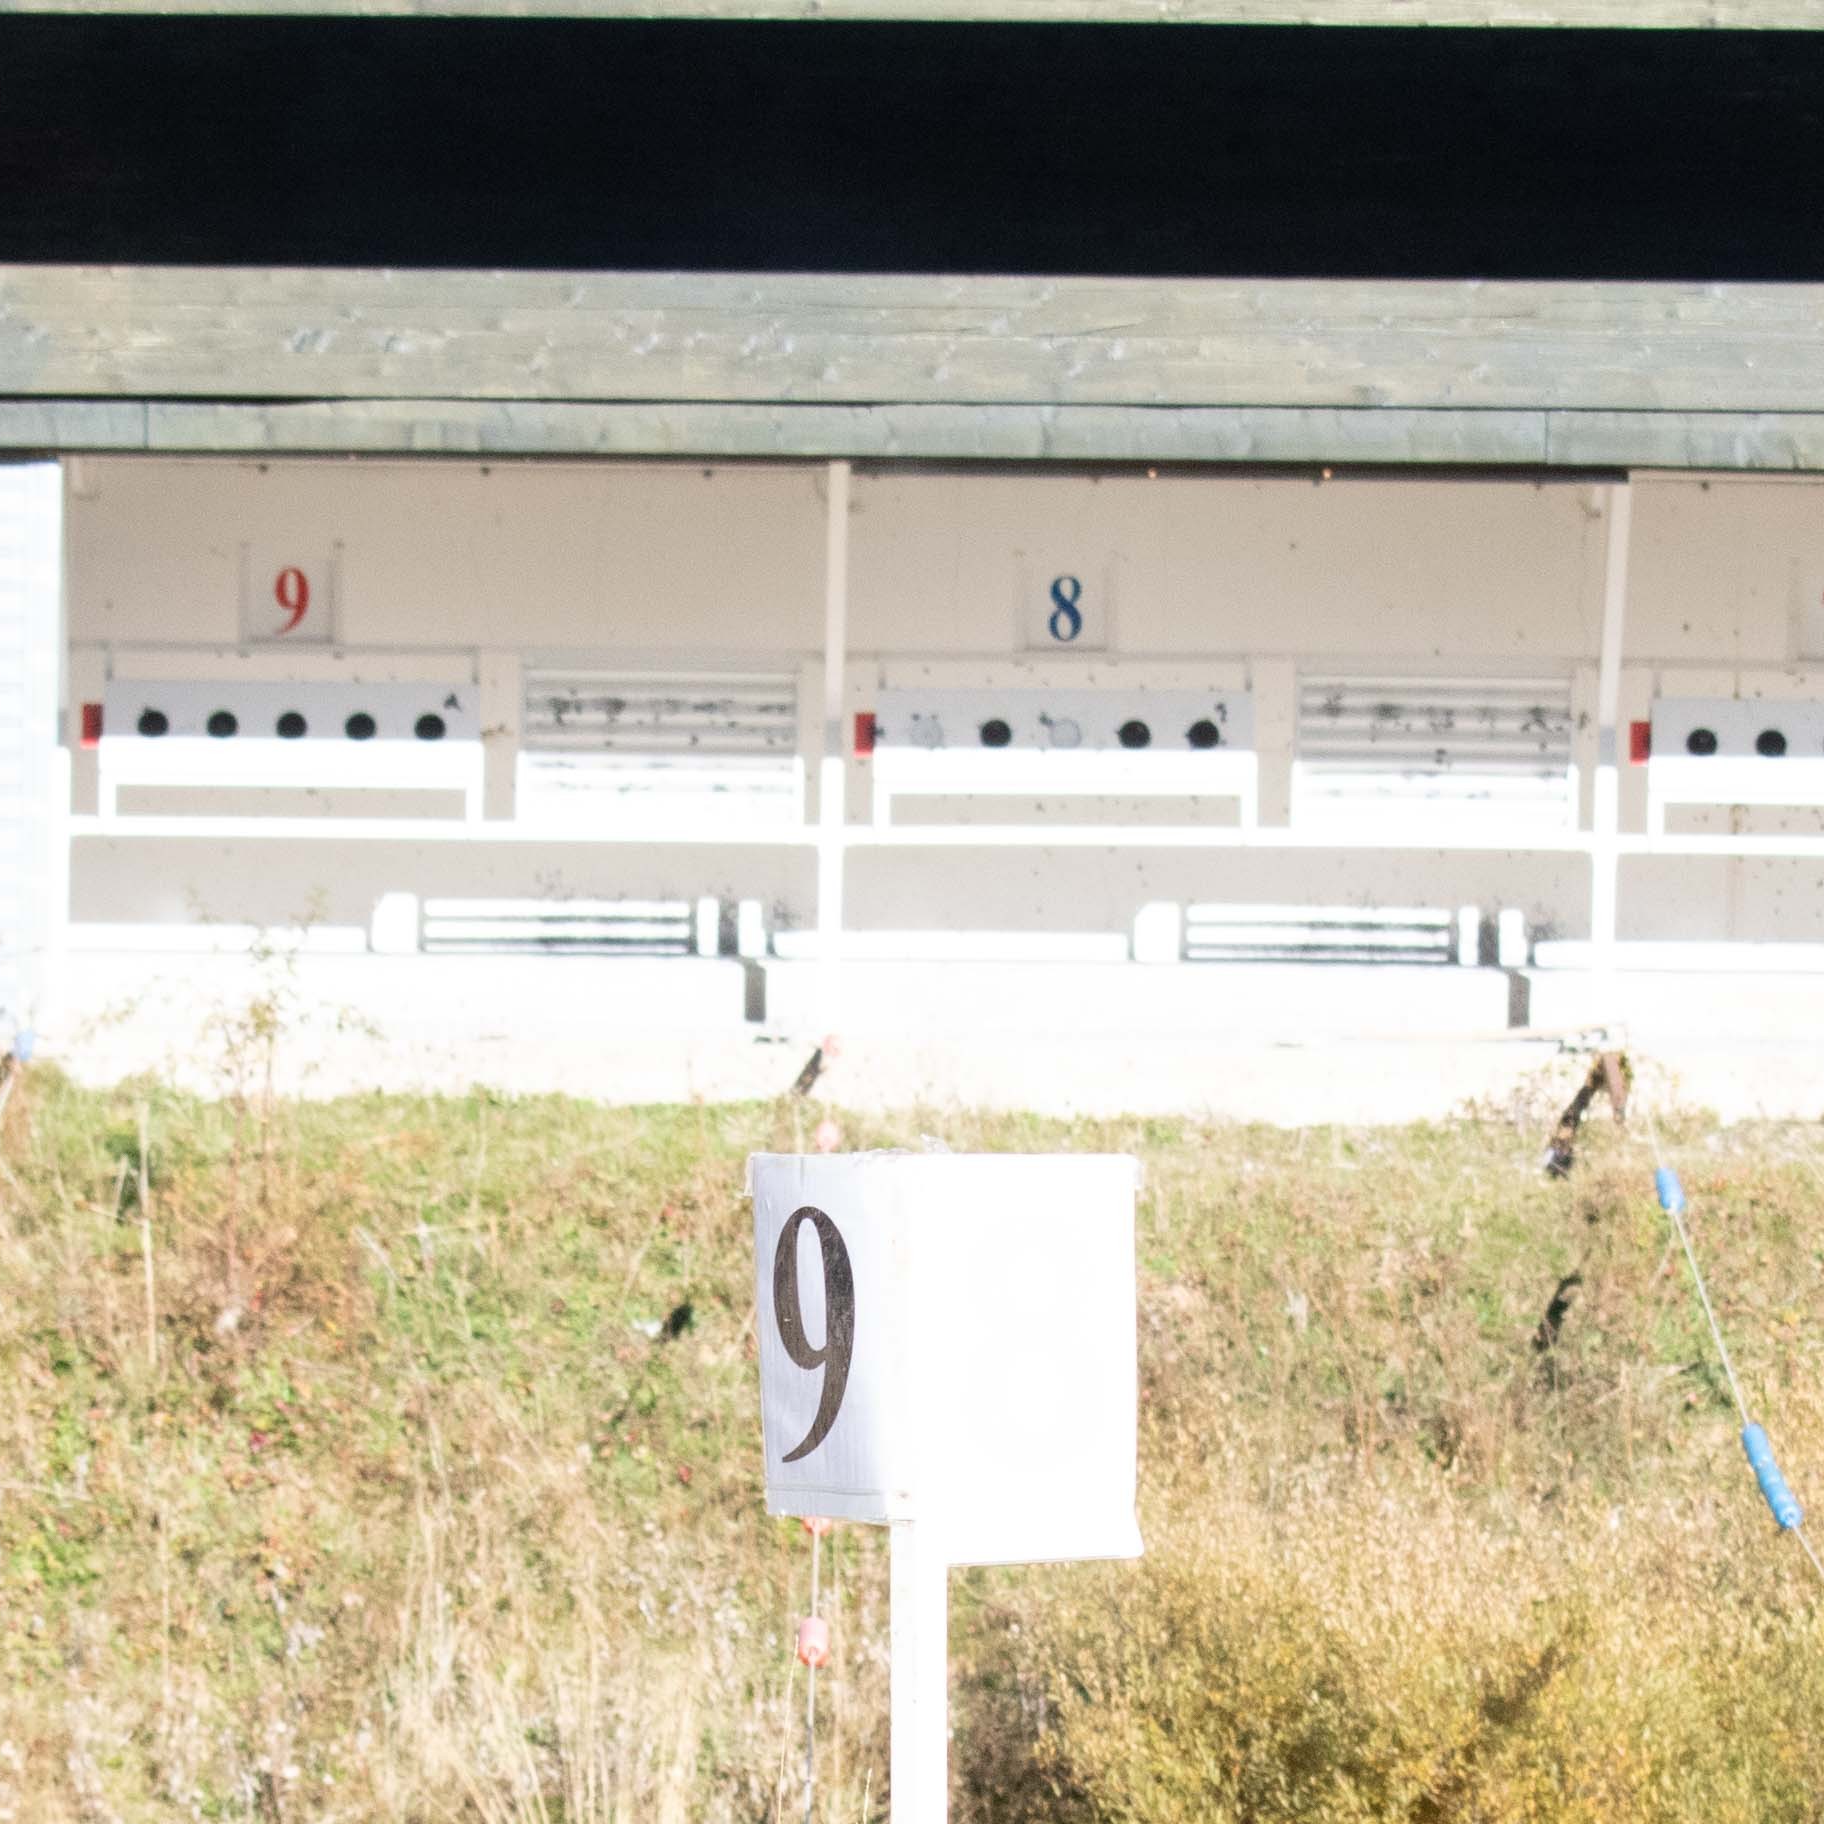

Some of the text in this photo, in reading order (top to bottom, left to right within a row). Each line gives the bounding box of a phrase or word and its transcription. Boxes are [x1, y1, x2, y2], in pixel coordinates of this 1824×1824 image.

[274, 566, 310, 635] 9
[1048, 576, 1083, 641] 8
[773, 1206, 855, 1463] 9
